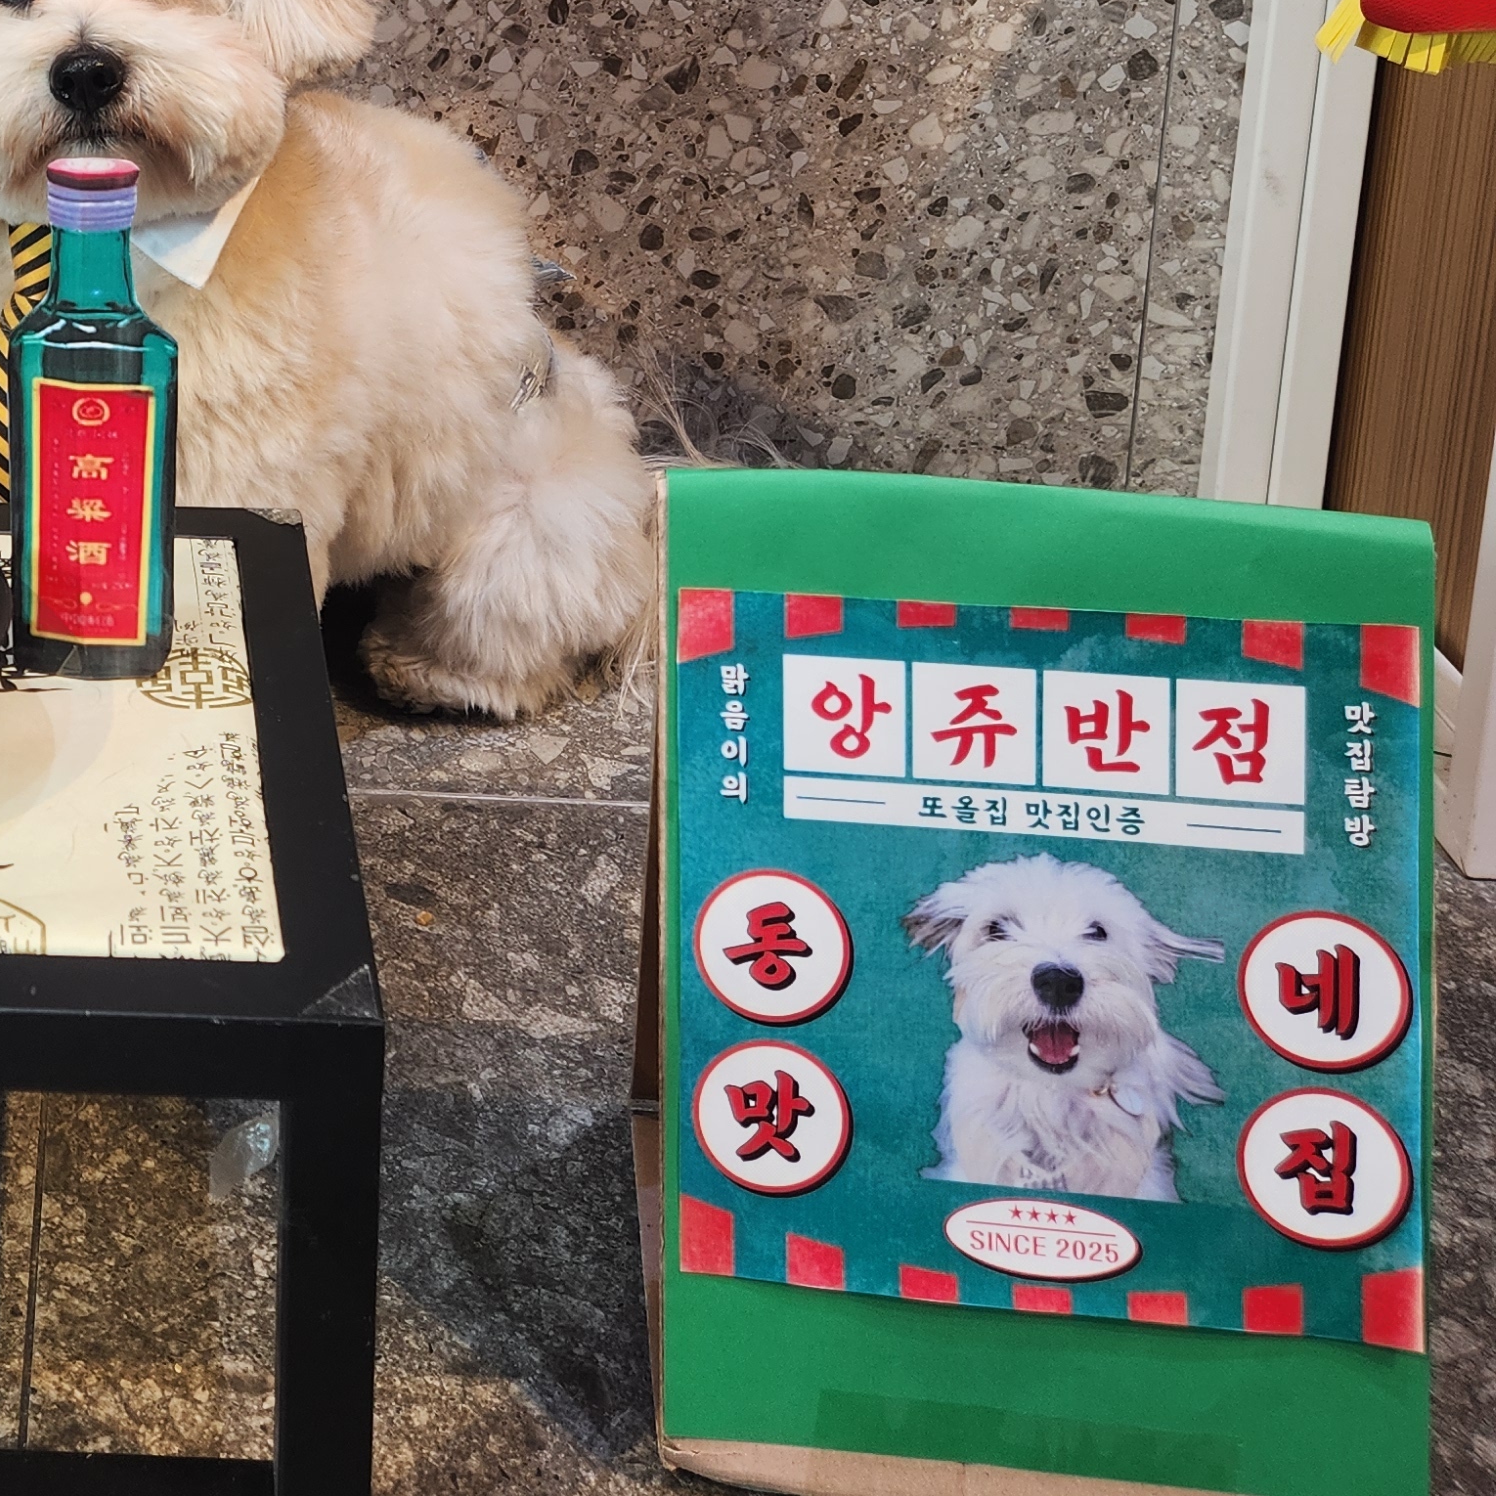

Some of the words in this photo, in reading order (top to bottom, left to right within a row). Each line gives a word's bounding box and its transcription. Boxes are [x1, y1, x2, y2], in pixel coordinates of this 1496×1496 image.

[809, 673, 1270, 787] 앙쥬반점
[1343, 700, 1377, 847] 맛집탐방
[918, 795, 1007, 826] 또올집
[1025, 799, 1146, 836] 맛집인증
[722, 901, 813, 991] 동
[1274, 944, 1361, 1041] 네
[723, 1069, 816, 1161] 맛
[1275, 1119, 1358, 1217] 집
[969, 1230, 1047, 1257] SINCE
[1056, 1238, 1119, 1264] 2025
